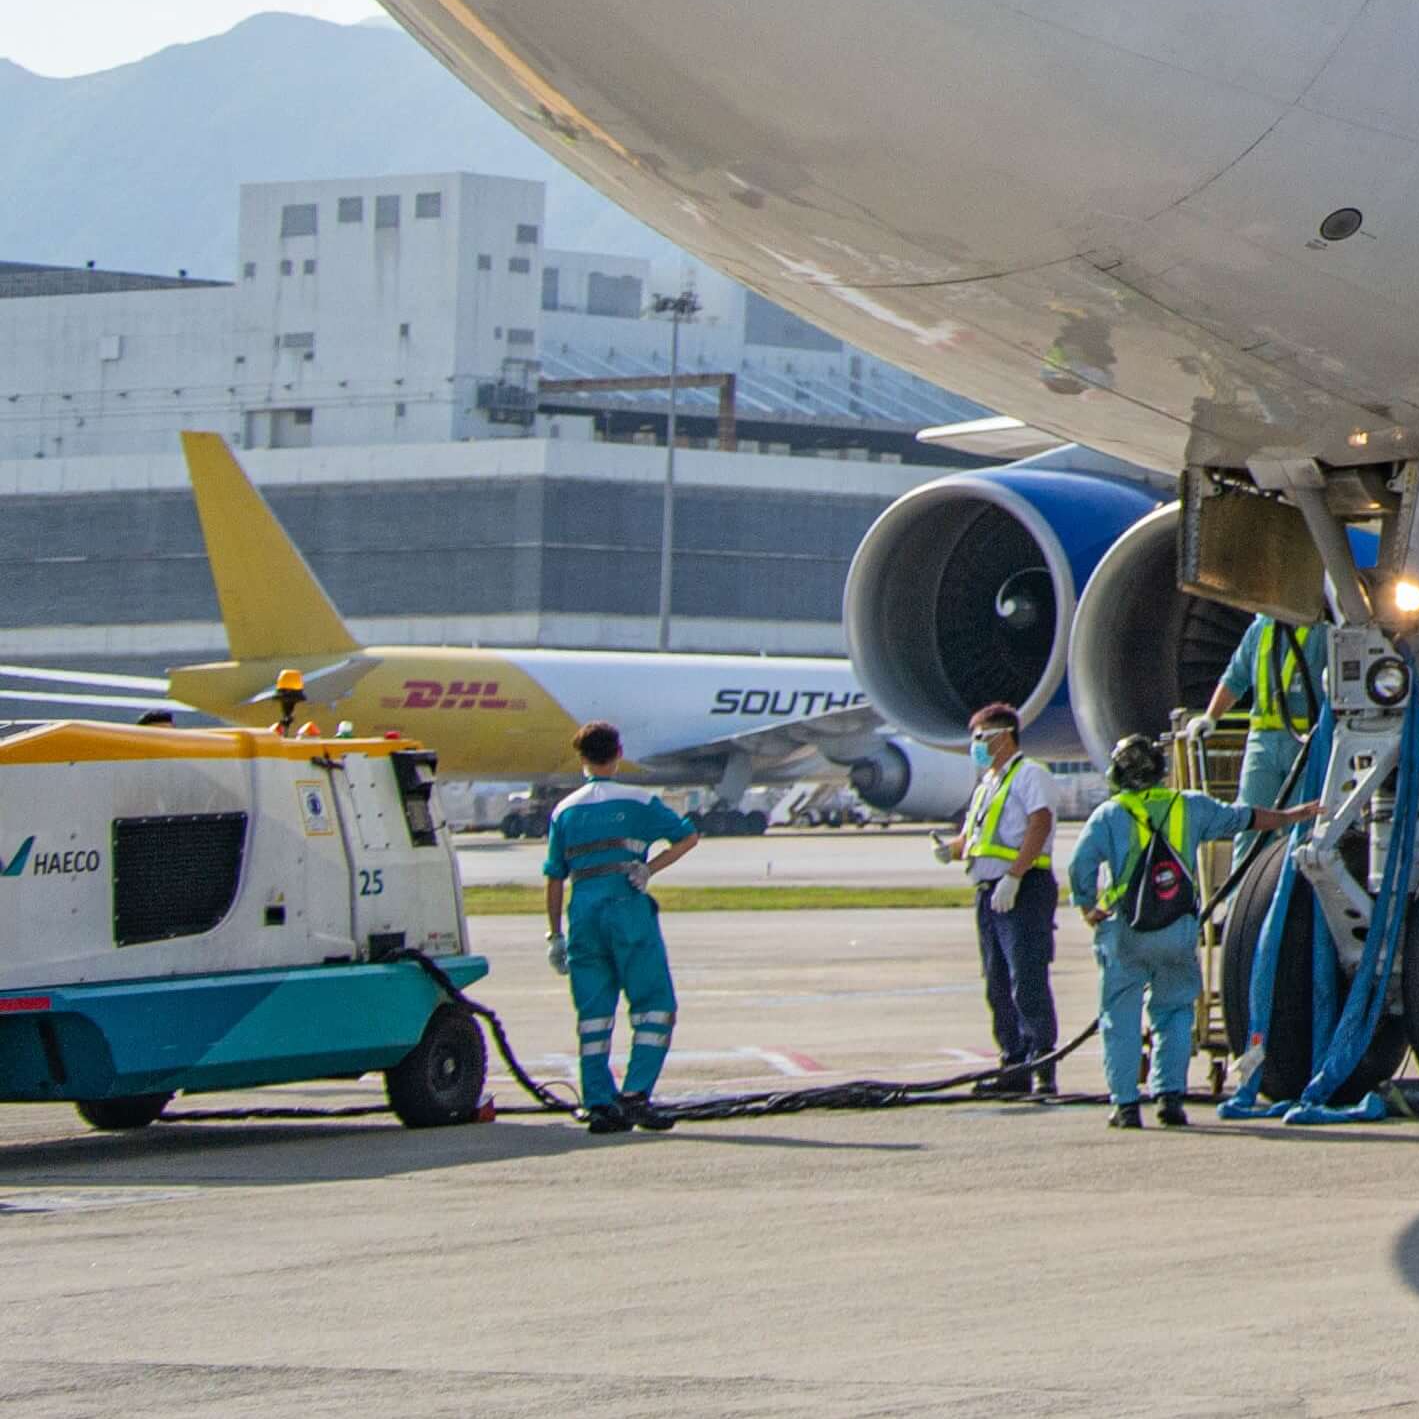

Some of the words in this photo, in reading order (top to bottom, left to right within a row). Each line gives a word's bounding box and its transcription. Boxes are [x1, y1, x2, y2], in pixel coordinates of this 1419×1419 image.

[402, 681, 508, 709] DHL
[33, 849, 100, 876] HAECO
[358, 868, 385, 896] 25
